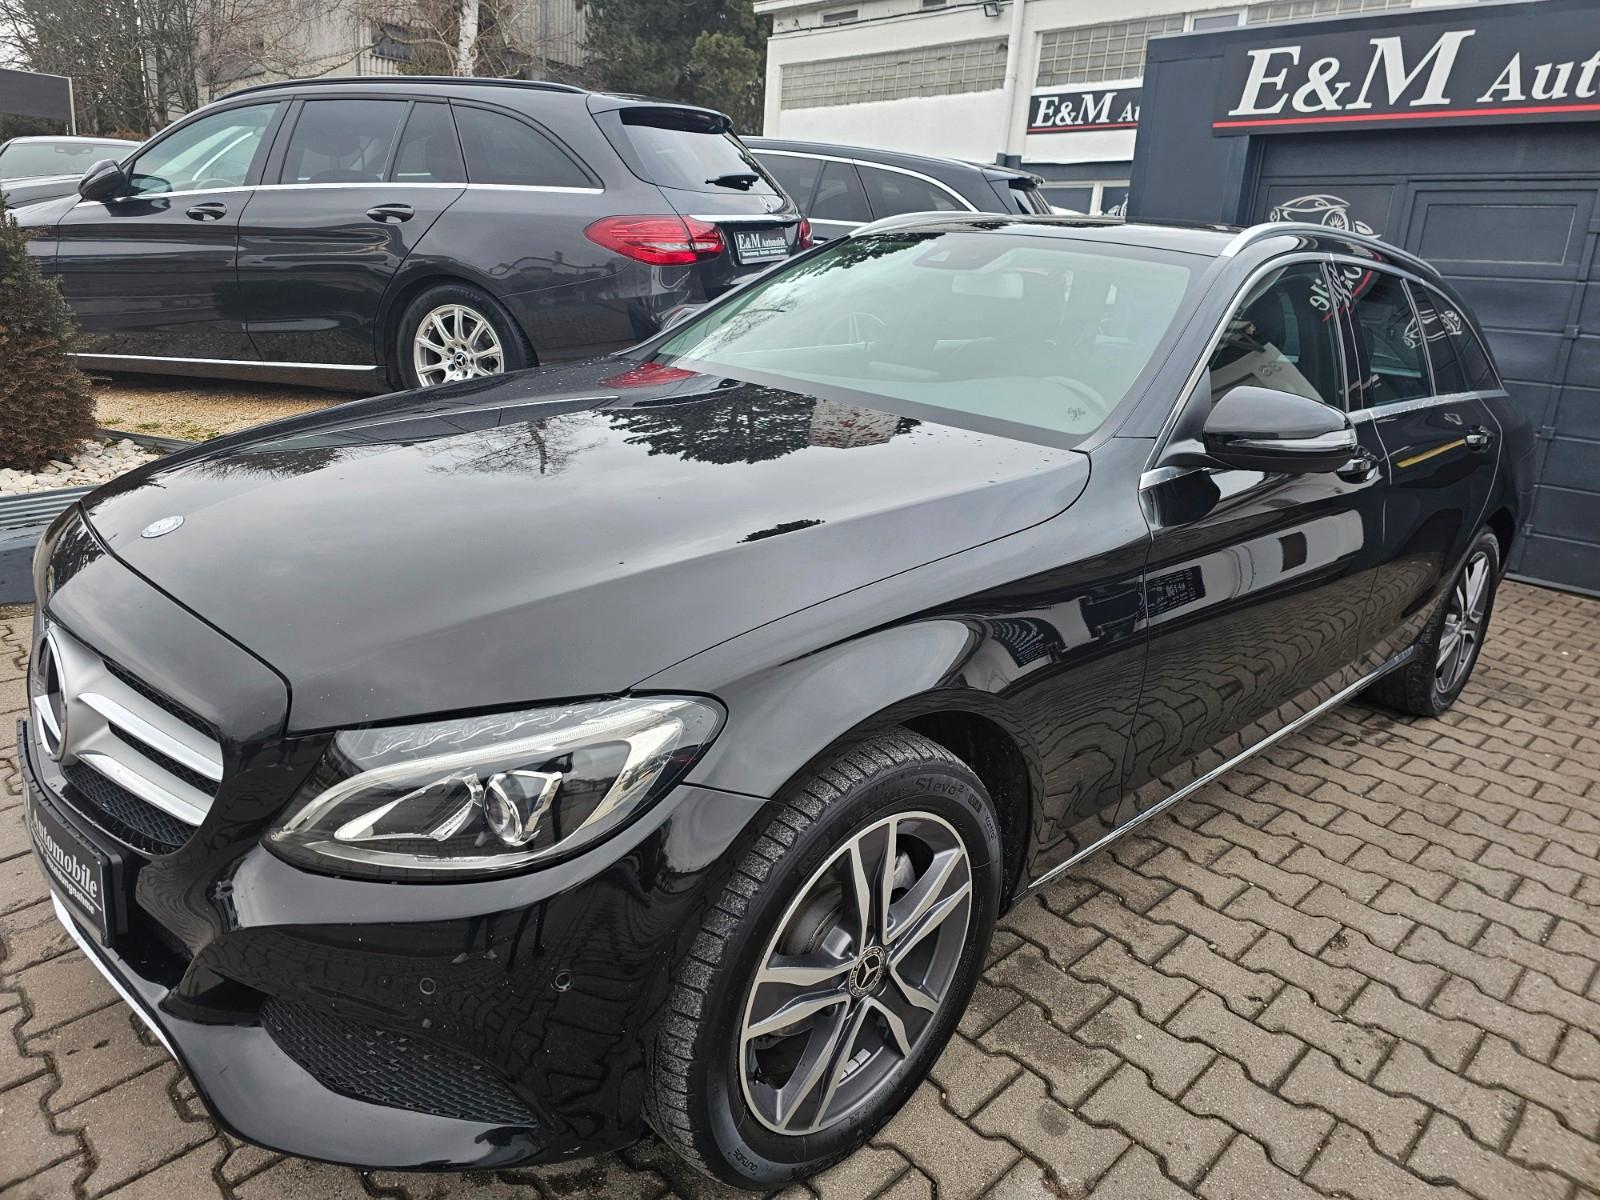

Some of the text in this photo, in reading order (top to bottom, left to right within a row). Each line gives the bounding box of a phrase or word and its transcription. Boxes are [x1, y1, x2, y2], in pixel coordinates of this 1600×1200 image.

[1228, 29, 1600, 117] E&M Aut
[1032, 92, 1117, 127] E&M
[738, 233, 760, 249] E&M
[31, 807, 98, 898] Automobile
